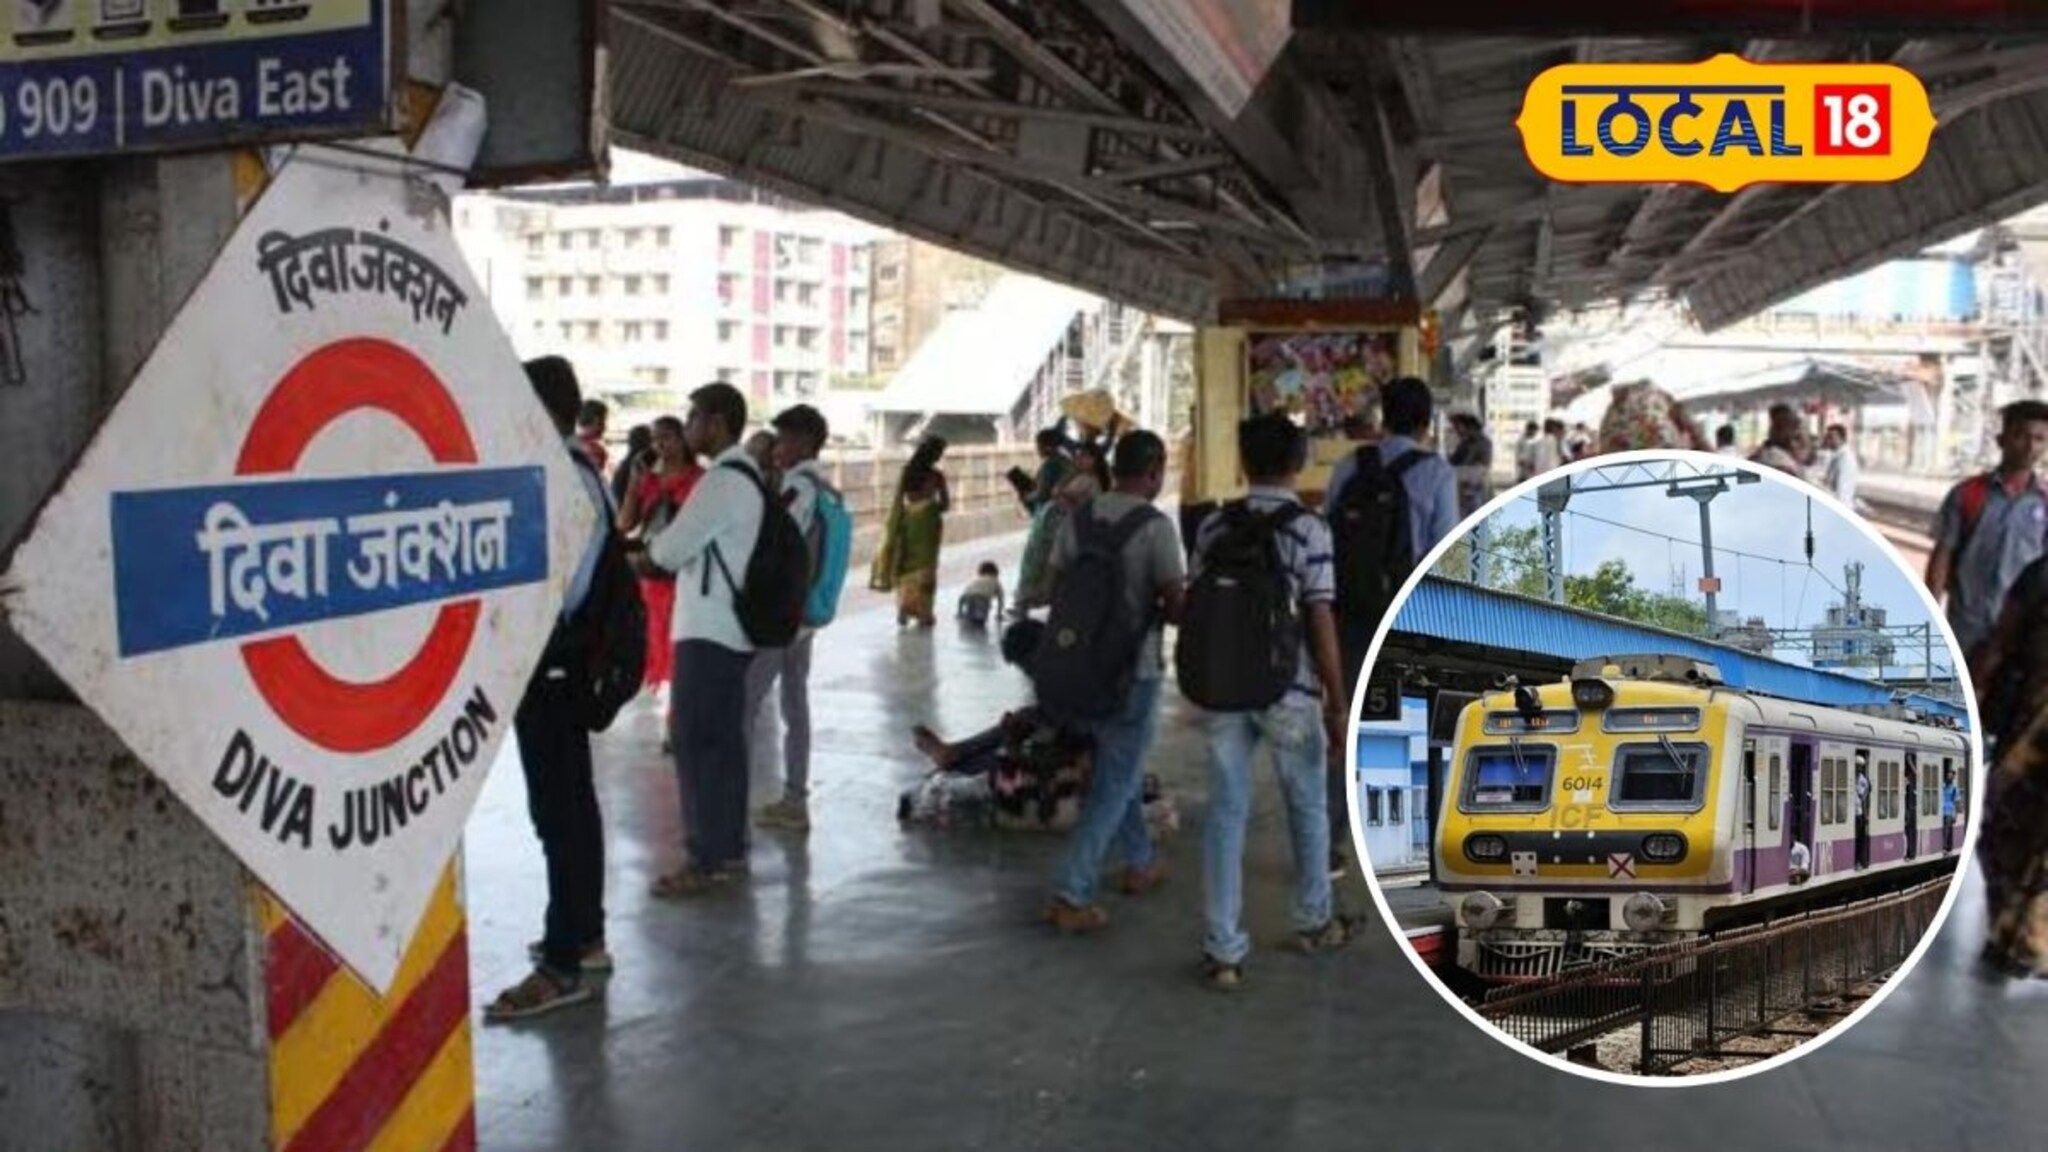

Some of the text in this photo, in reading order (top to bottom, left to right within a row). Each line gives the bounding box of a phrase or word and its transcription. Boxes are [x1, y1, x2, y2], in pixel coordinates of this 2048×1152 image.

[17, 75, 99, 138] 909
[142, 64, 240, 127] Diva
[258, 56, 351, 117] East
[195, 490, 513, 622] दिवा जंक्शन
[1368, 687, 1388, 713] 5
[211, 683, 498, 851] DIVA JUNCTION
[1562, 776, 1604, 791] 6014
[1550, 803, 1606, 829] ICF
